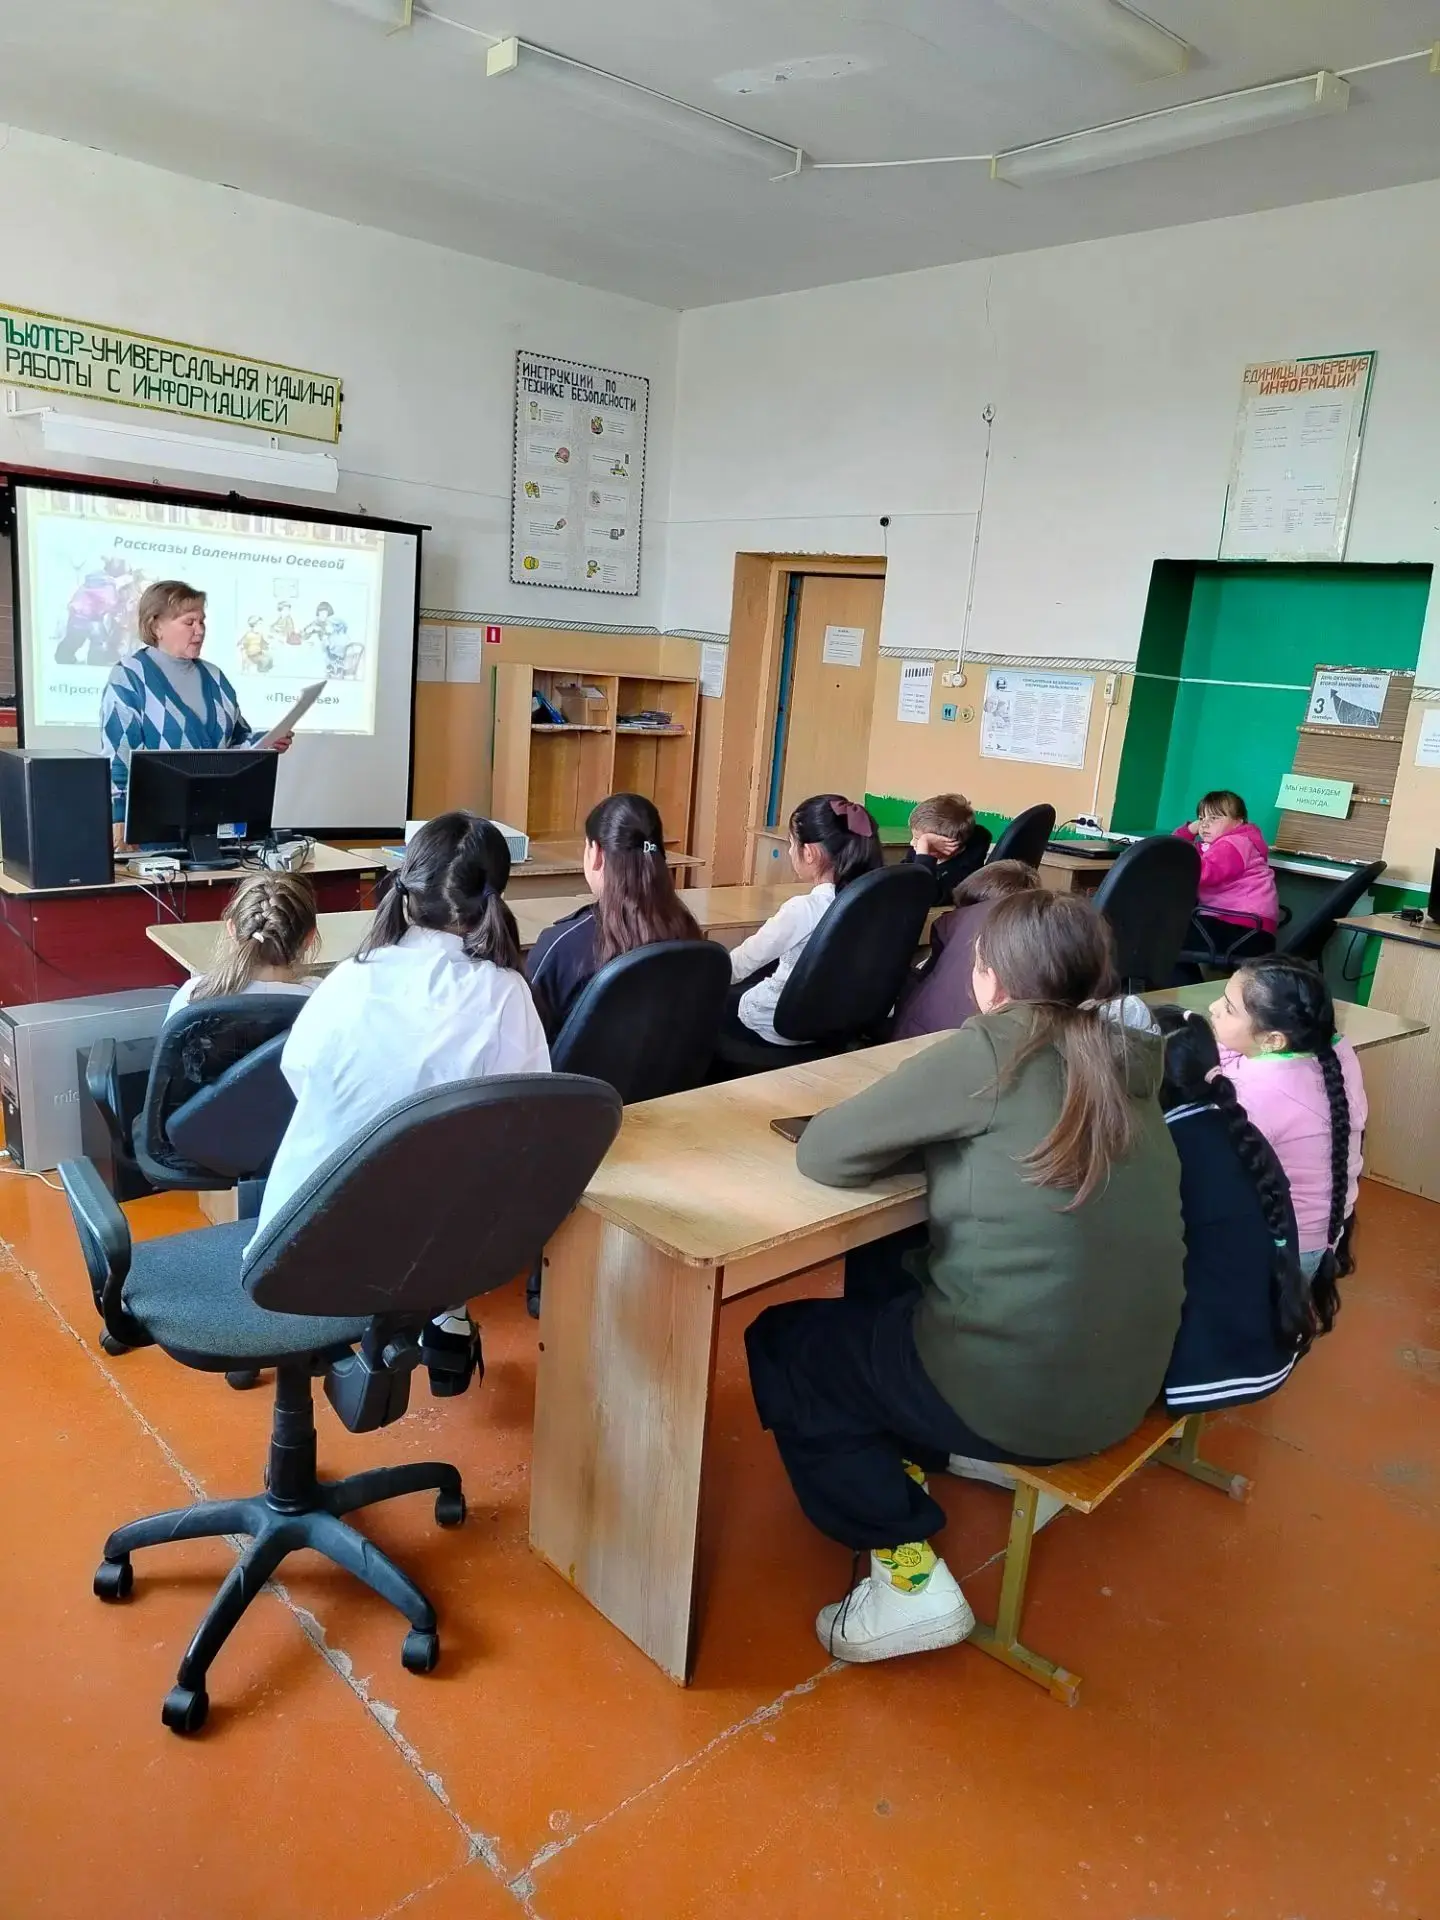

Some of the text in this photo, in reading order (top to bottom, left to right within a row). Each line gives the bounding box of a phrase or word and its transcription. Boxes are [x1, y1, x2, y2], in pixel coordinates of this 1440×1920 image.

[522, 362, 617, 393] ИНСТРУКЦИИ ПО
[1243, 356, 1369, 384] ЕДИНИЦЫ ИЗМЕРЕНИЯ
[1259, 372, 1356, 395] ИНФОРМАЦИИ
[6, 347, 288, 426] РАБОТЫ С ИНФОРМАЦИЕЙ
[266, 371, 335, 408] МАШИНА
[521, 377, 637, 412] ТЕХНИКЕ БЕЗОПАСНОСТИ
[113, 536, 345, 571] Рассказы Валентины Осеевой
[1313, 697, 1325, 714] 3
[1285, 783, 1341, 797] МЫ НЕ ЗАБУДЕМ
